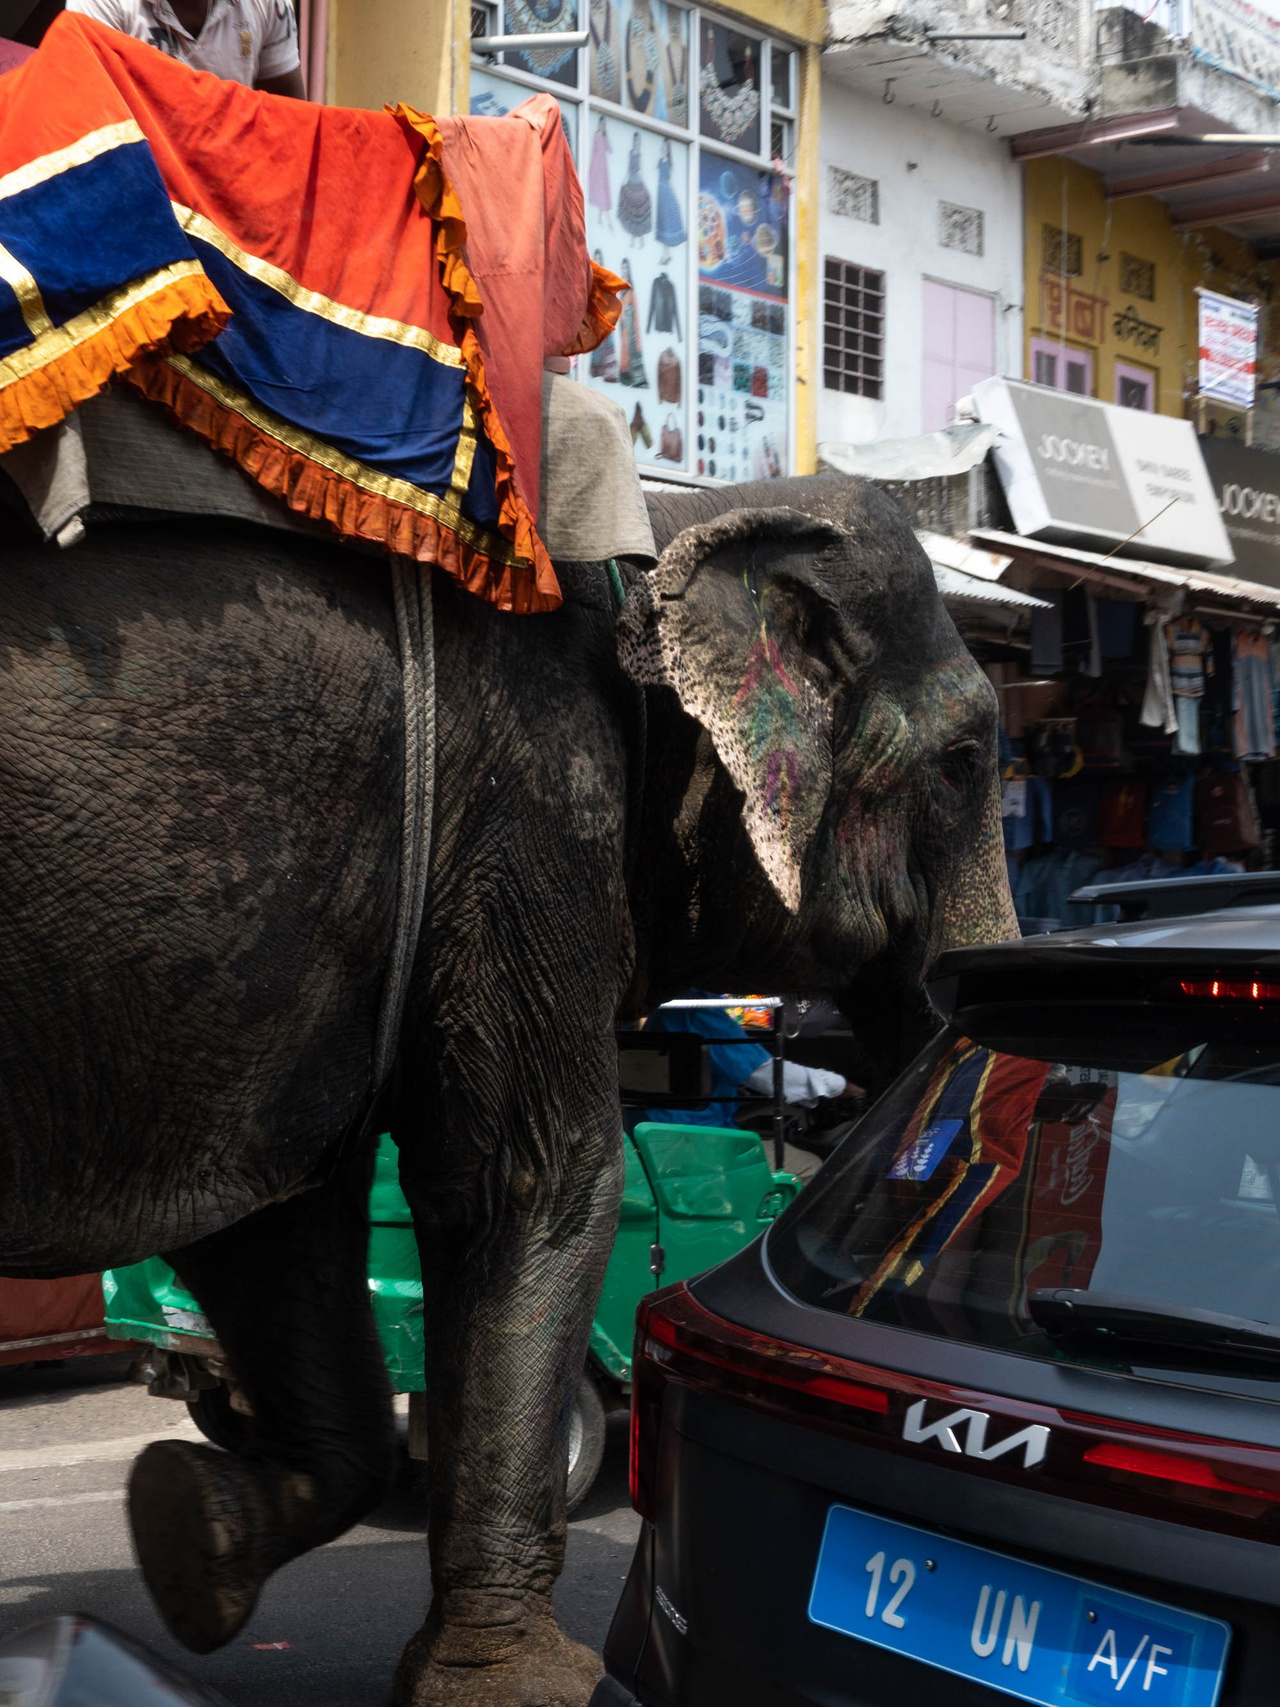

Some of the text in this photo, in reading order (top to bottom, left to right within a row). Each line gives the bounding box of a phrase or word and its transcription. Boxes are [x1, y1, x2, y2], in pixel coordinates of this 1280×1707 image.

[1217, 483, 1280, 524] JOCKE
[902, 1398, 1051, 1469] KIA
[865, 1550, 1173, 1692] 12 UN A/F
